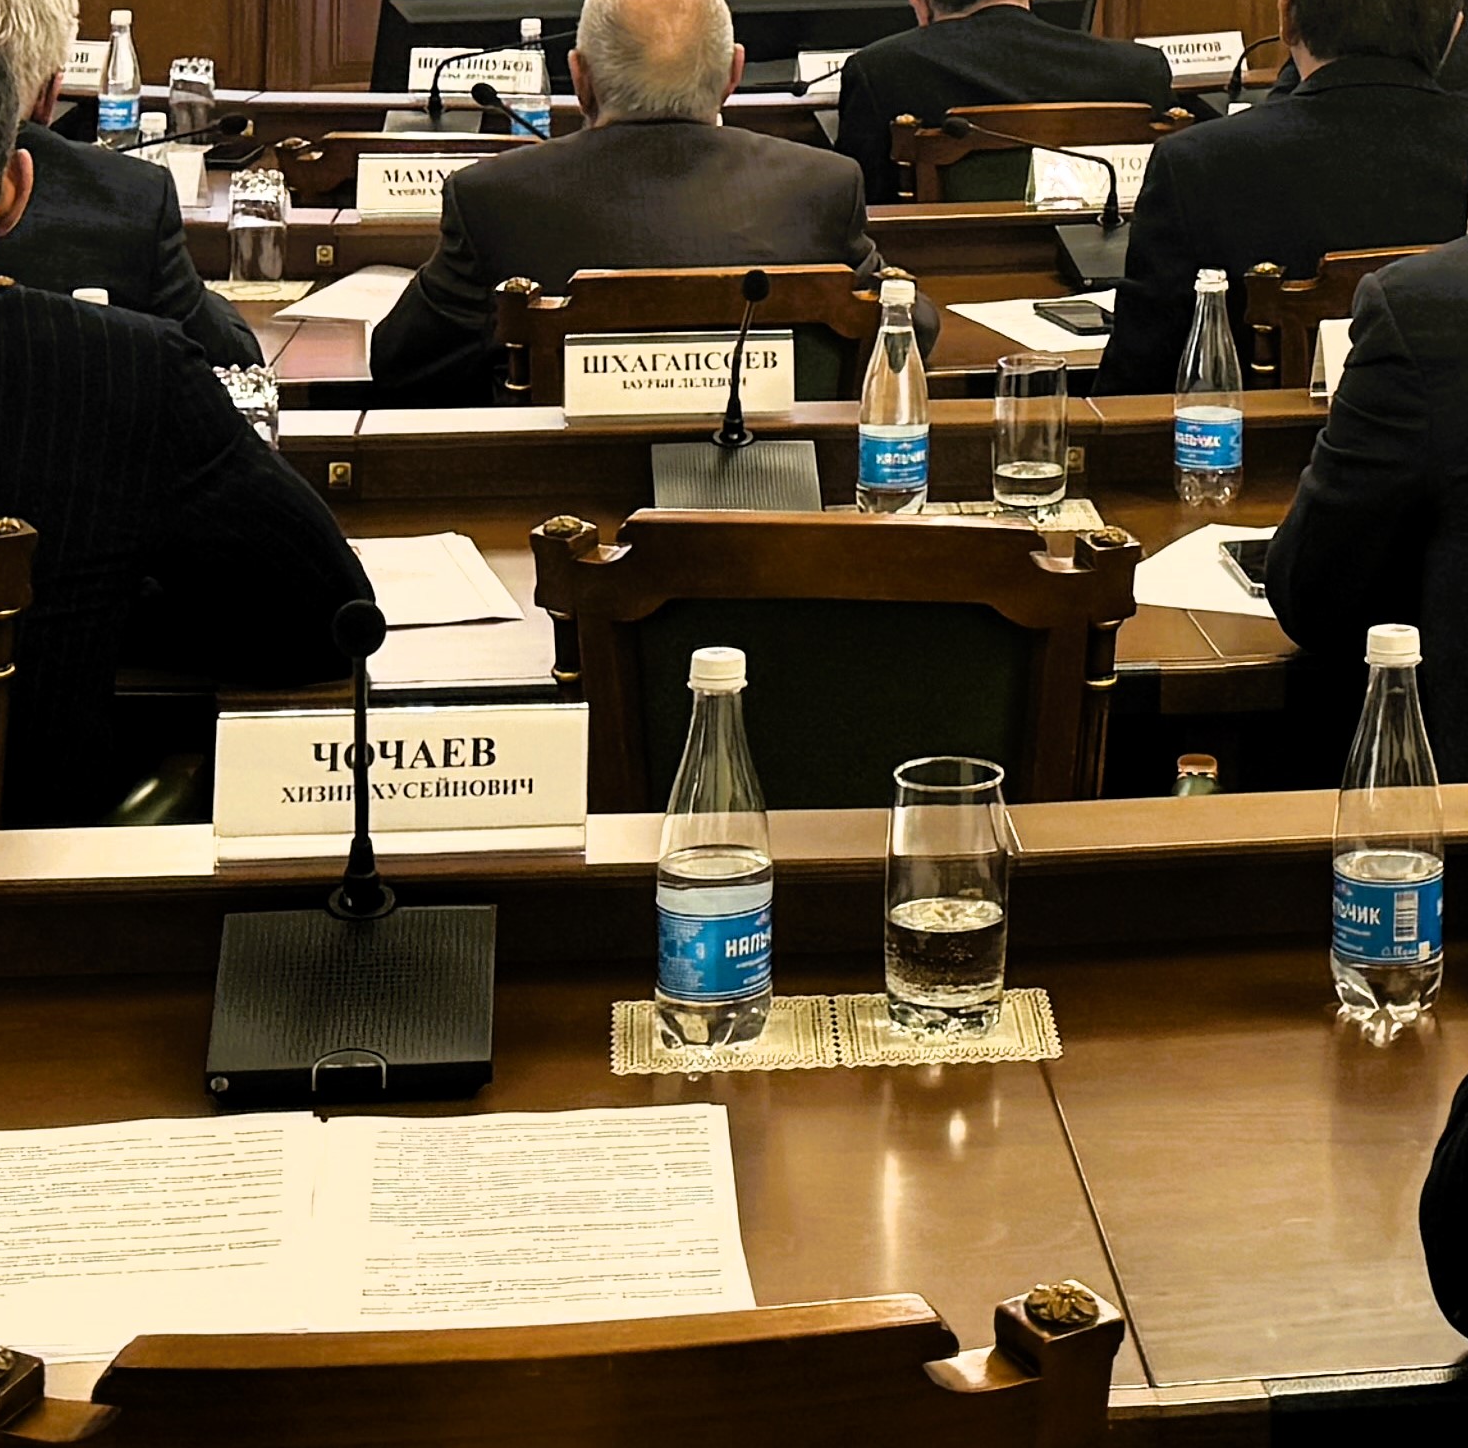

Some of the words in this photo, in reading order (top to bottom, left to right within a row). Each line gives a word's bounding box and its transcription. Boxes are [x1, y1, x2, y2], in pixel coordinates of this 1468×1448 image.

[418, 56, 533, 73] ШЕНЦУКОВ
[383, 169, 454, 184] МАМХ
[311, 736, 496, 772] ЧОЧАЕВ
[371, 777, 533, 800] ХУСЕЙНОВИЧ
[725, 926, 772, 958] НАЛЬ
